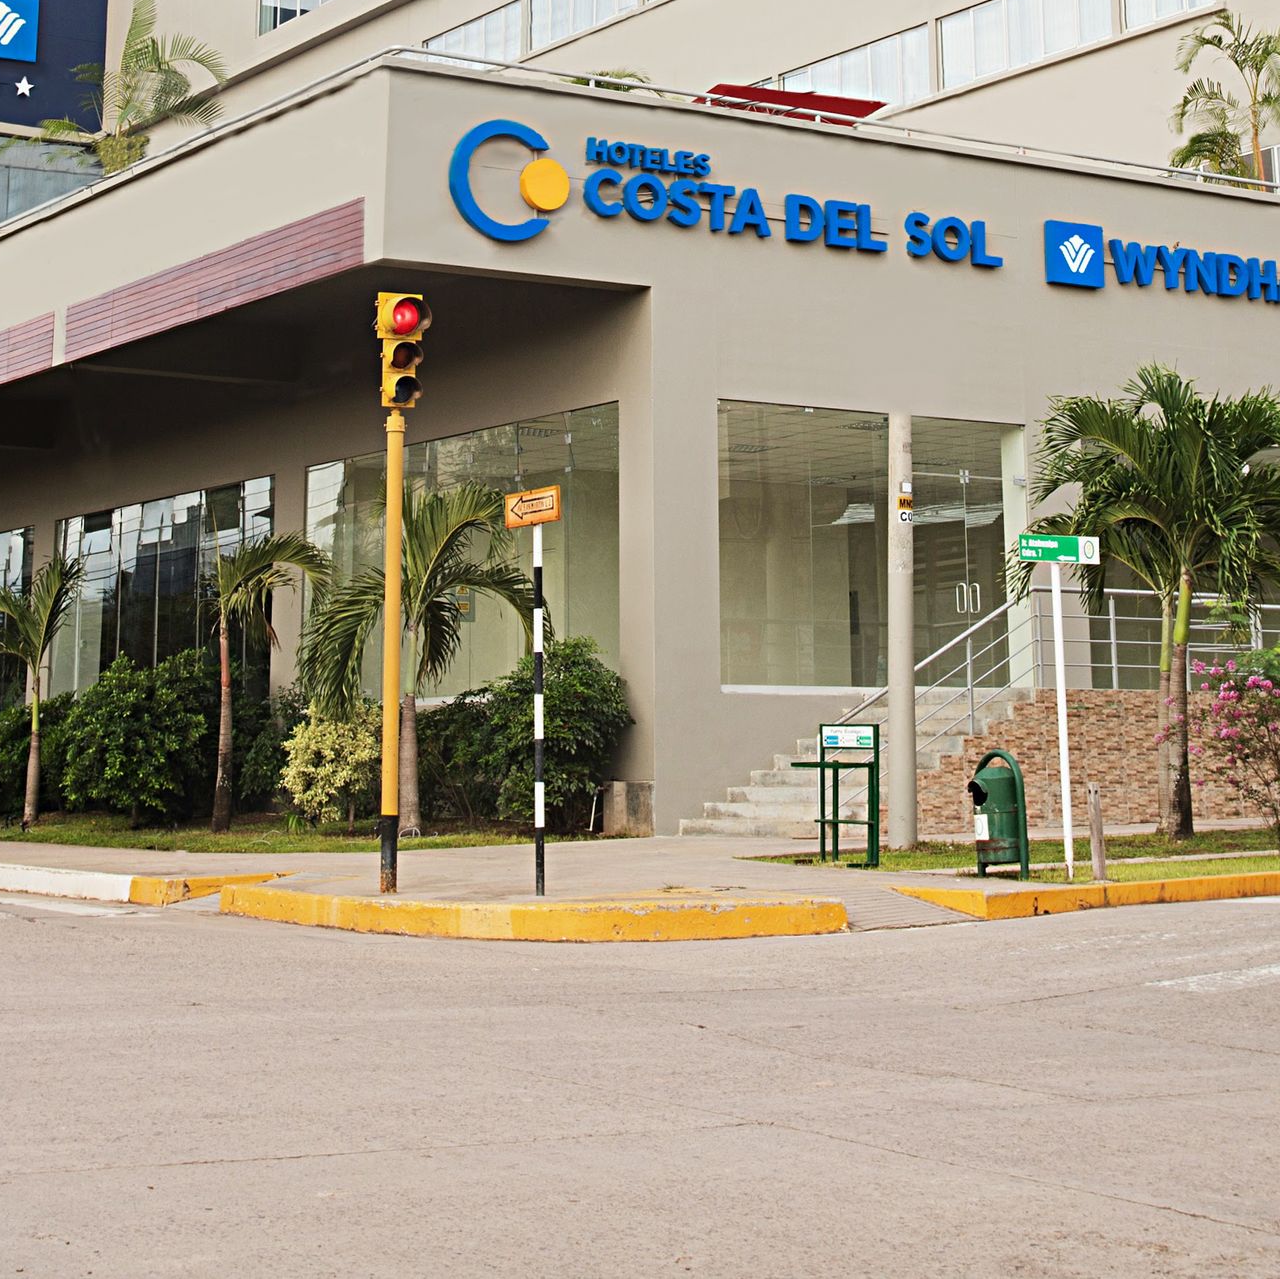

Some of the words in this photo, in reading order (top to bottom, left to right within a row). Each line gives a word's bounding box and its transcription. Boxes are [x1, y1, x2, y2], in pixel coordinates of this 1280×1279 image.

[586, 137, 711, 177] HOTELES
[583, 167, 771, 237] COSTA
[785, 193, 888, 252] DEL
[904, 211, 1004, 268] SOL
